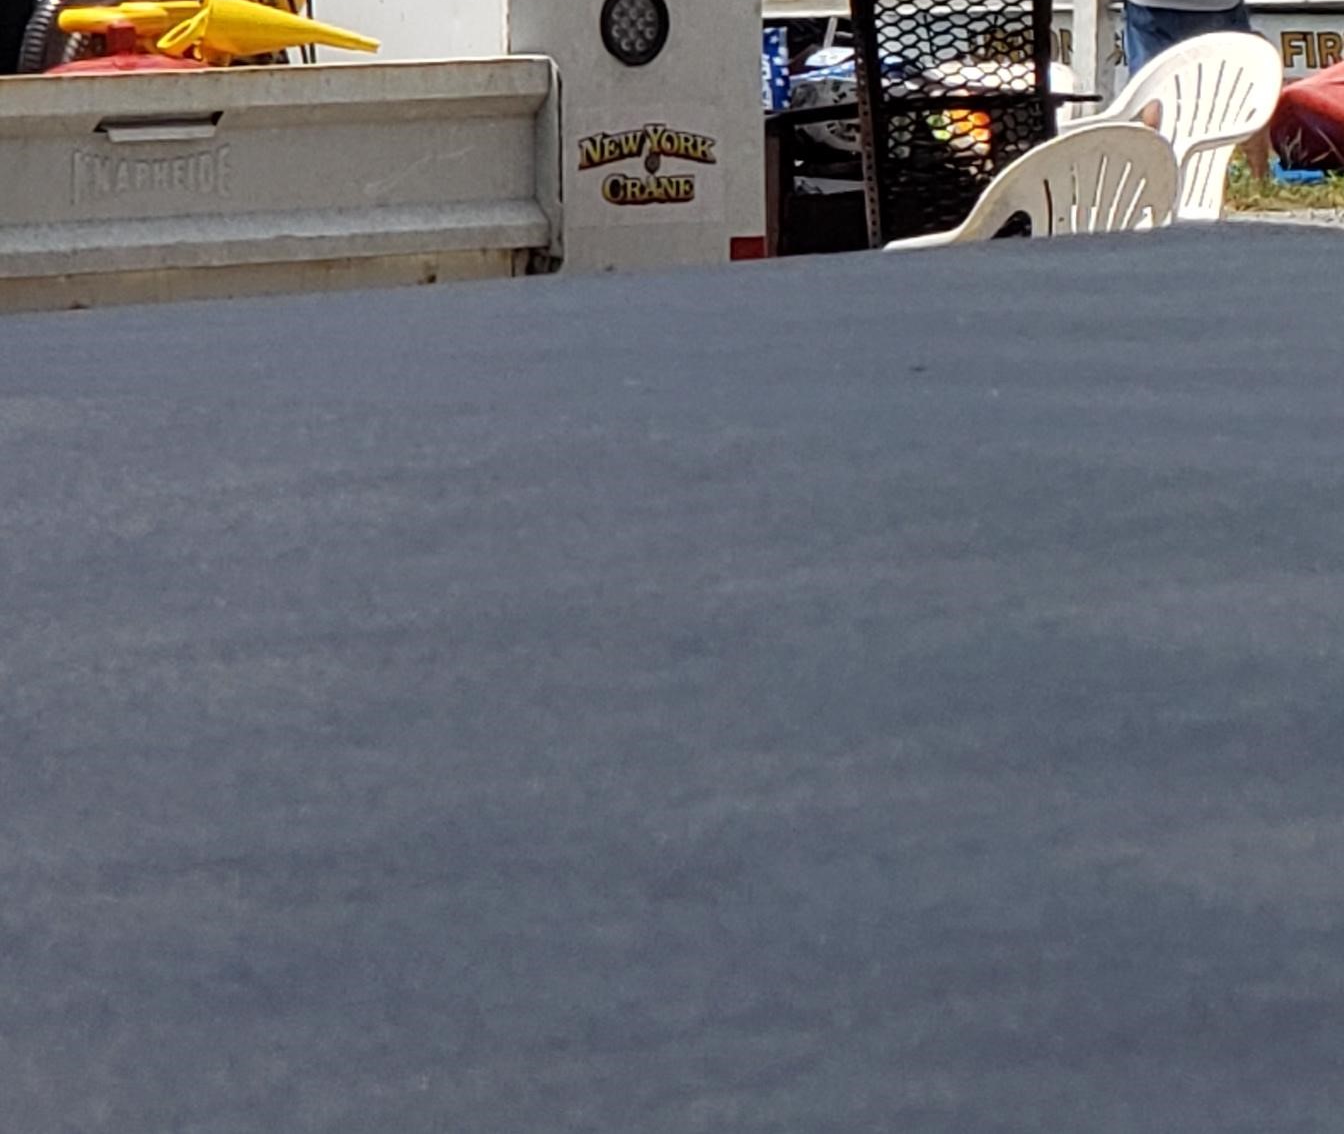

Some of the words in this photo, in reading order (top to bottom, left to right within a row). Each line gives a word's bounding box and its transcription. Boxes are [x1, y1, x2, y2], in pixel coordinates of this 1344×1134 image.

[578, 130, 645, 171] NEW
[643, 123, 717, 165] YORK
[602, 173, 695, 205] CRANE
